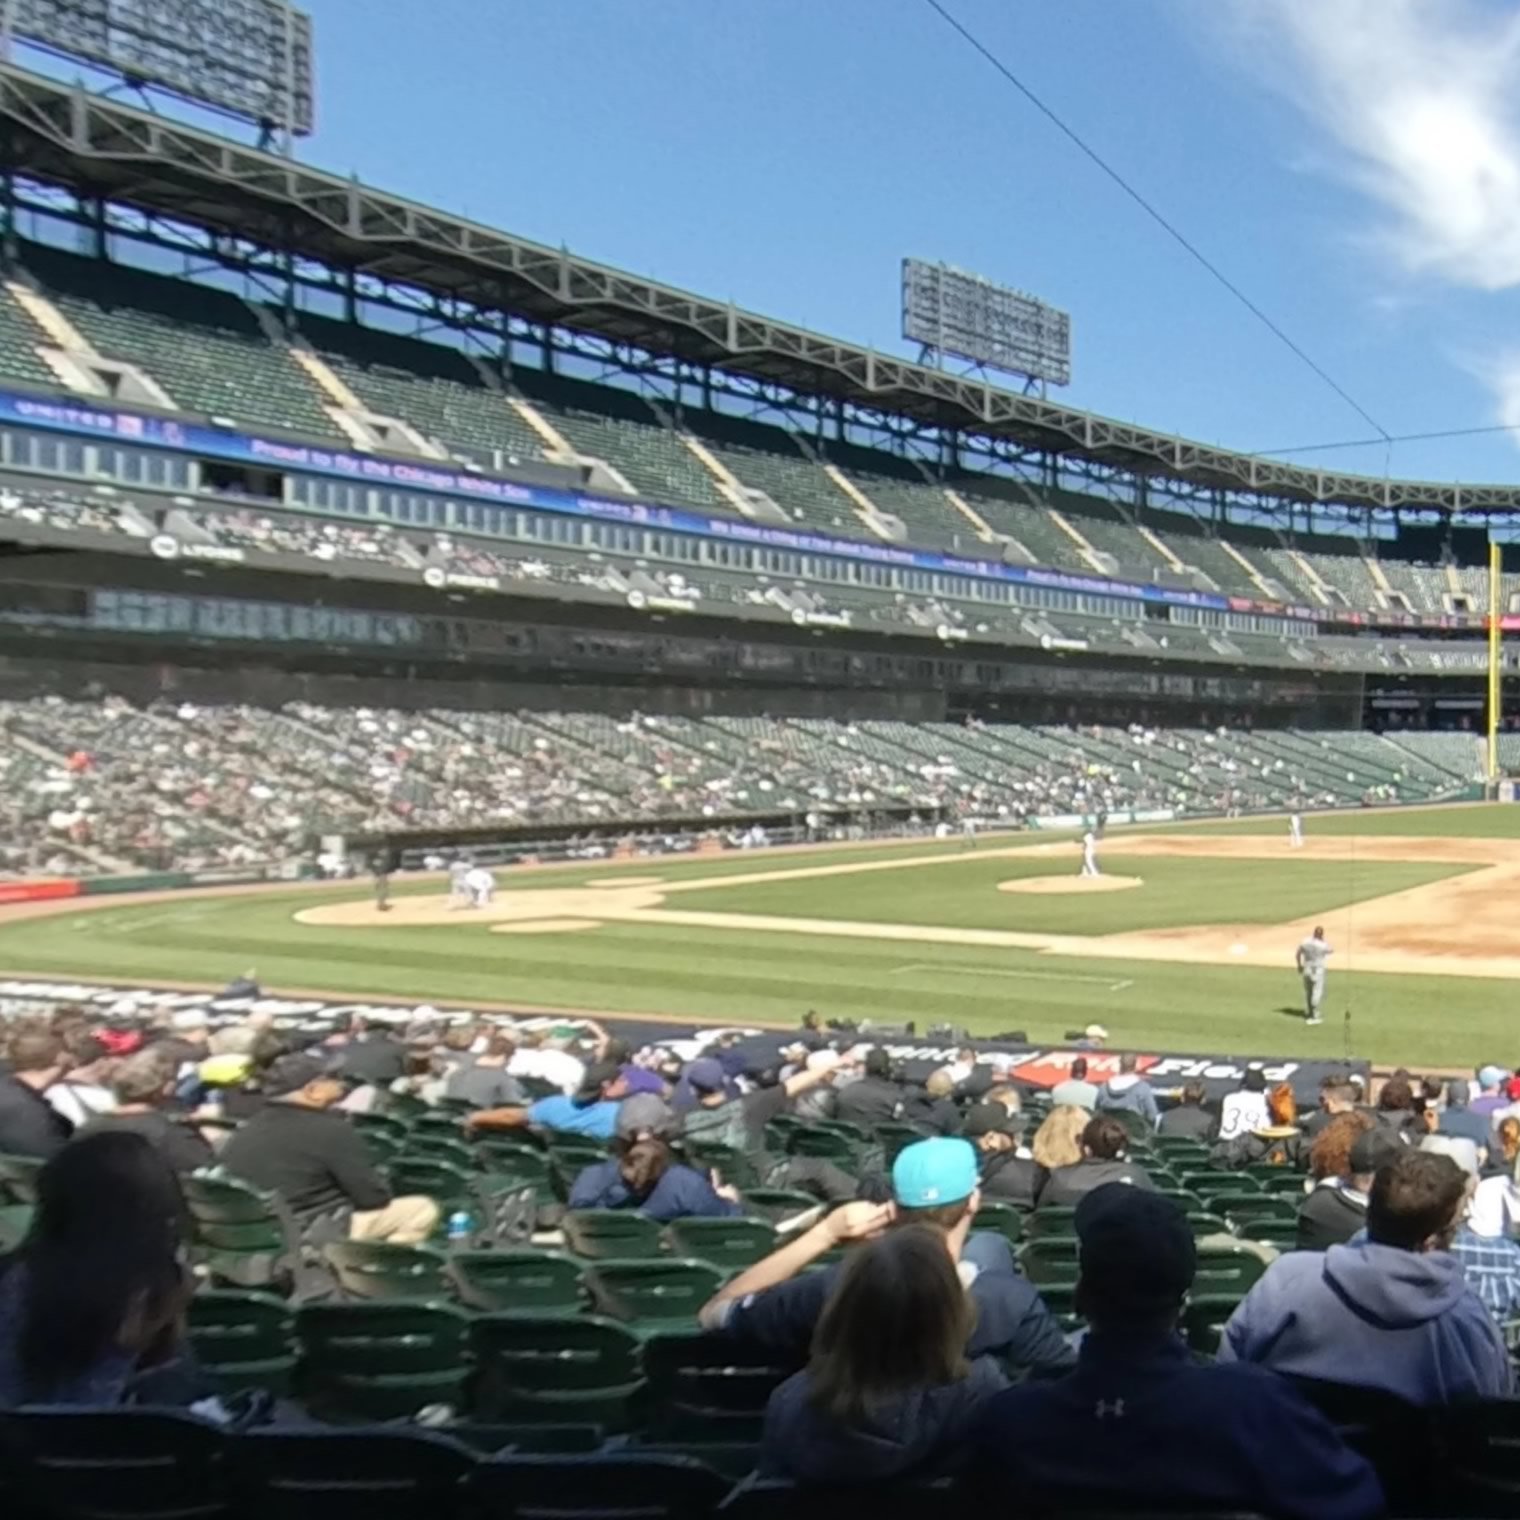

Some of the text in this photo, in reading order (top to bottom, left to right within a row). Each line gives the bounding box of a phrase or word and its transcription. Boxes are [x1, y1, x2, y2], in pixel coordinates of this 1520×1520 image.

[14, 400, 113, 428] UNITED
[251, 438, 307, 462] Proud
[311, 450, 330, 466] to
[335, 454, 359, 472] fly
[363, 459, 390, 476] the
[393, 463, 454, 488] Chicago
[458, 475, 500, 495] White
